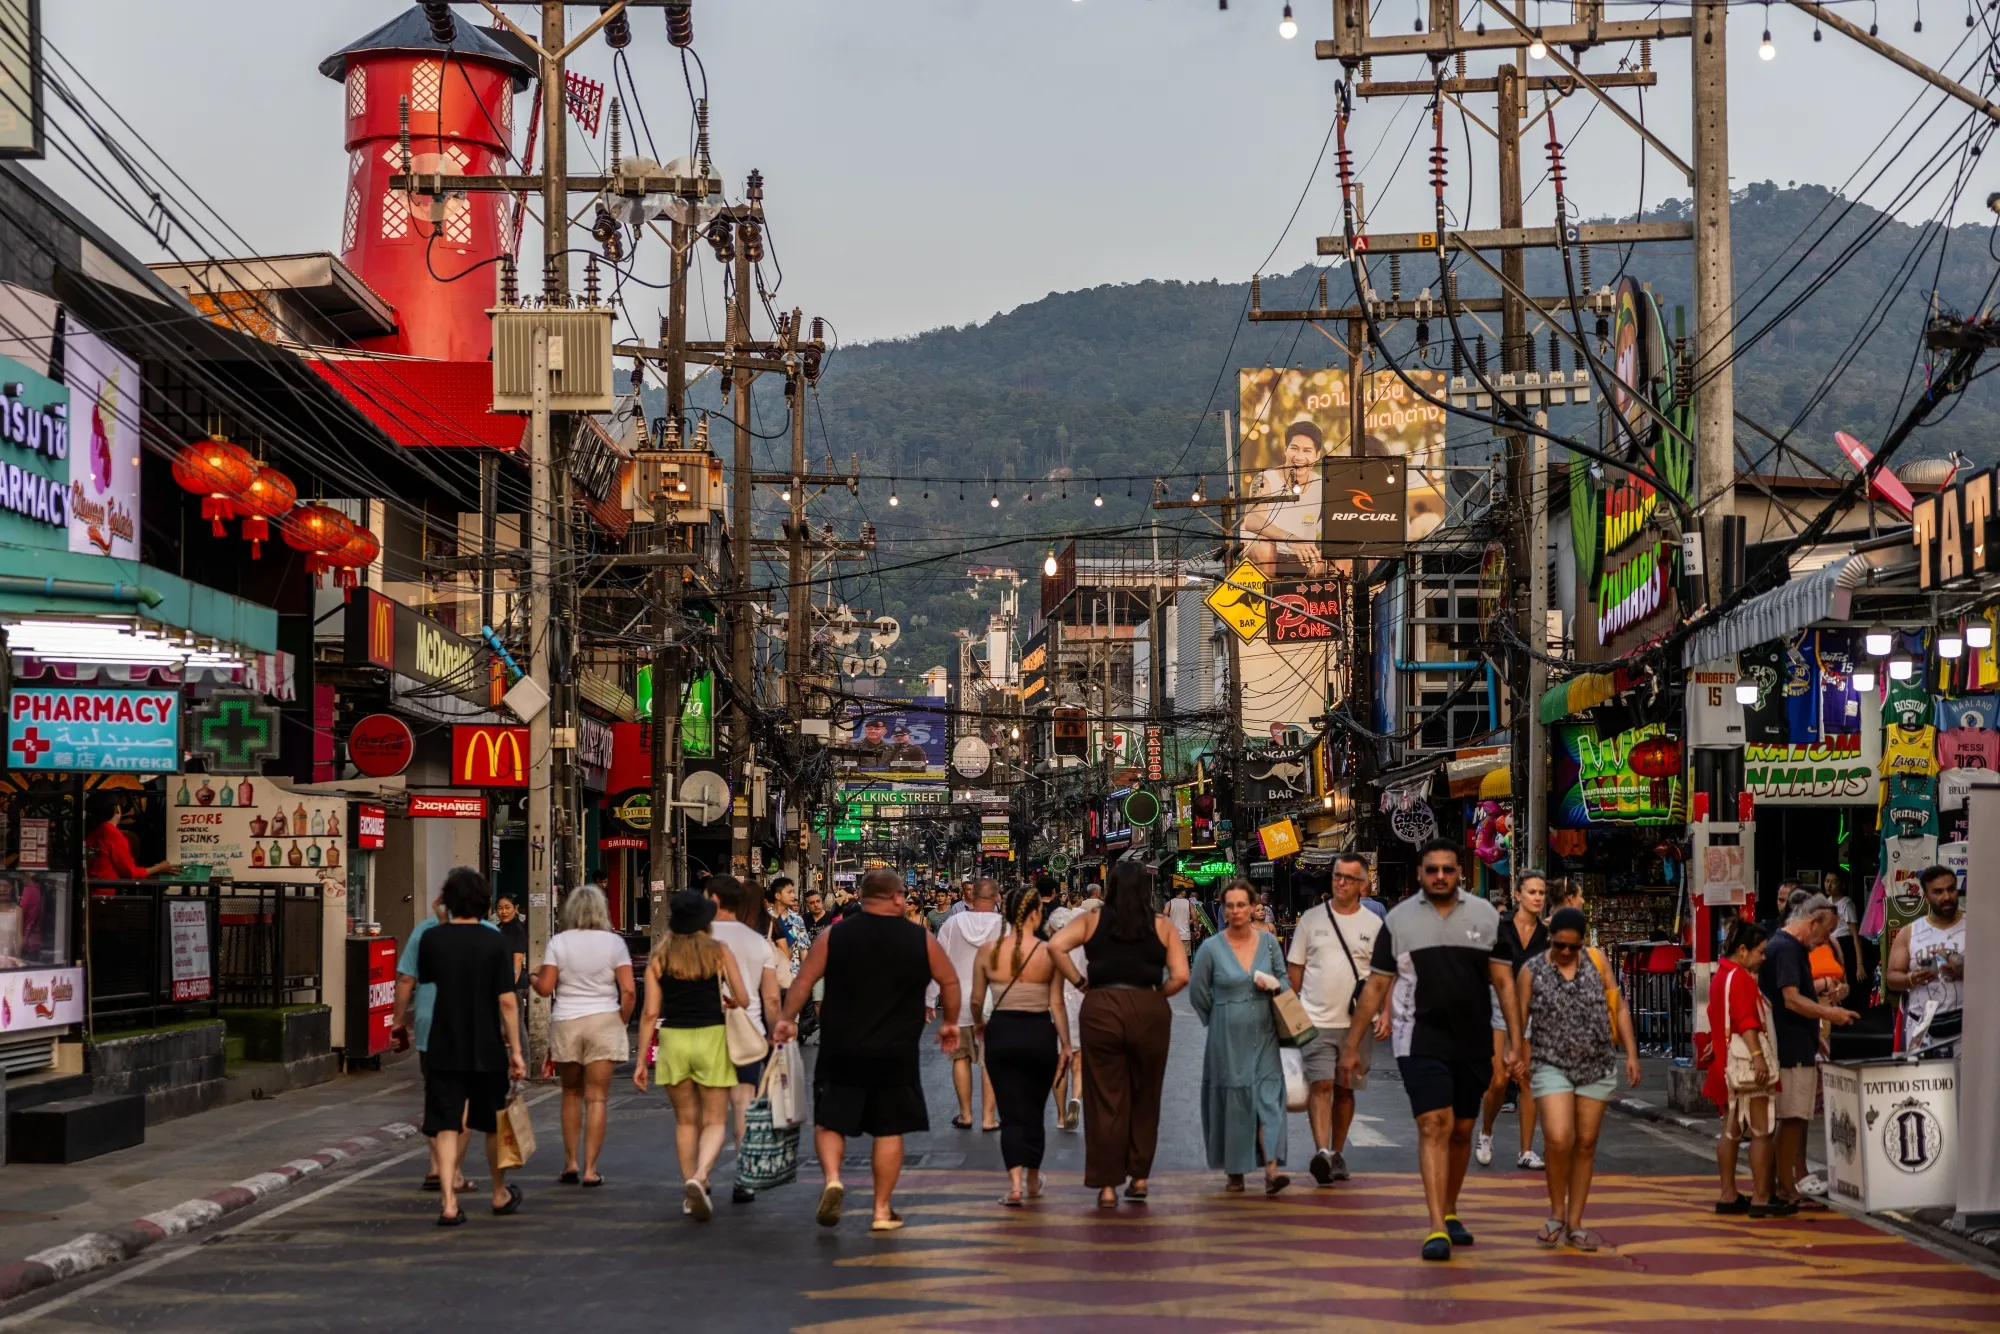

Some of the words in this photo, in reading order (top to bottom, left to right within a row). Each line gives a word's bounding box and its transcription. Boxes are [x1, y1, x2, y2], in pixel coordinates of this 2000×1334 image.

[1355, 237, 1367, 250] A
[1421, 233, 1433, 247] B
[1307, 378, 1404, 410] ความดชื่น
[1359, 513, 1398, 521] CURL
[1598, 541, 1661, 647] CANNABIS
[1309, 600, 1339, 615] BAR
[1239, 620, 1256, 628] BAR
[1841, 662, 1853, 673] 15
[1695, 672, 1736, 684] NUGGETS
[1708, 686, 1722, 706] 15
[12, 694, 173, 724] PHARMACY
[1893, 699, 1927, 713] BOSTON
[1951, 699, 1993, 713] HAALAND
[56, 727, 174, 751] صيدلية
[1146, 728, 1162, 781] TATTOO
[1957, 743, 1984, 752] MESSI
[101, 753, 173, 768] Аптека
[1890, 754, 1930, 769] LAKERS
[845, 793, 897, 802] WALKING
[900, 792, 942, 802] STREET
[1268, 789, 1294, 800] BAR
[180, 813, 223, 824] STORE
[1890, 808, 1930, 826] GRIZZLIES
[360, 816, 385, 836] EXCHANGE
[180, 835, 220, 844] DRINKS
[1360, 933, 1371, 942] Lee
[1864, 1080, 1910, 1095] TATTOO
[1912, 1078, 1954, 1092] STUDIO
